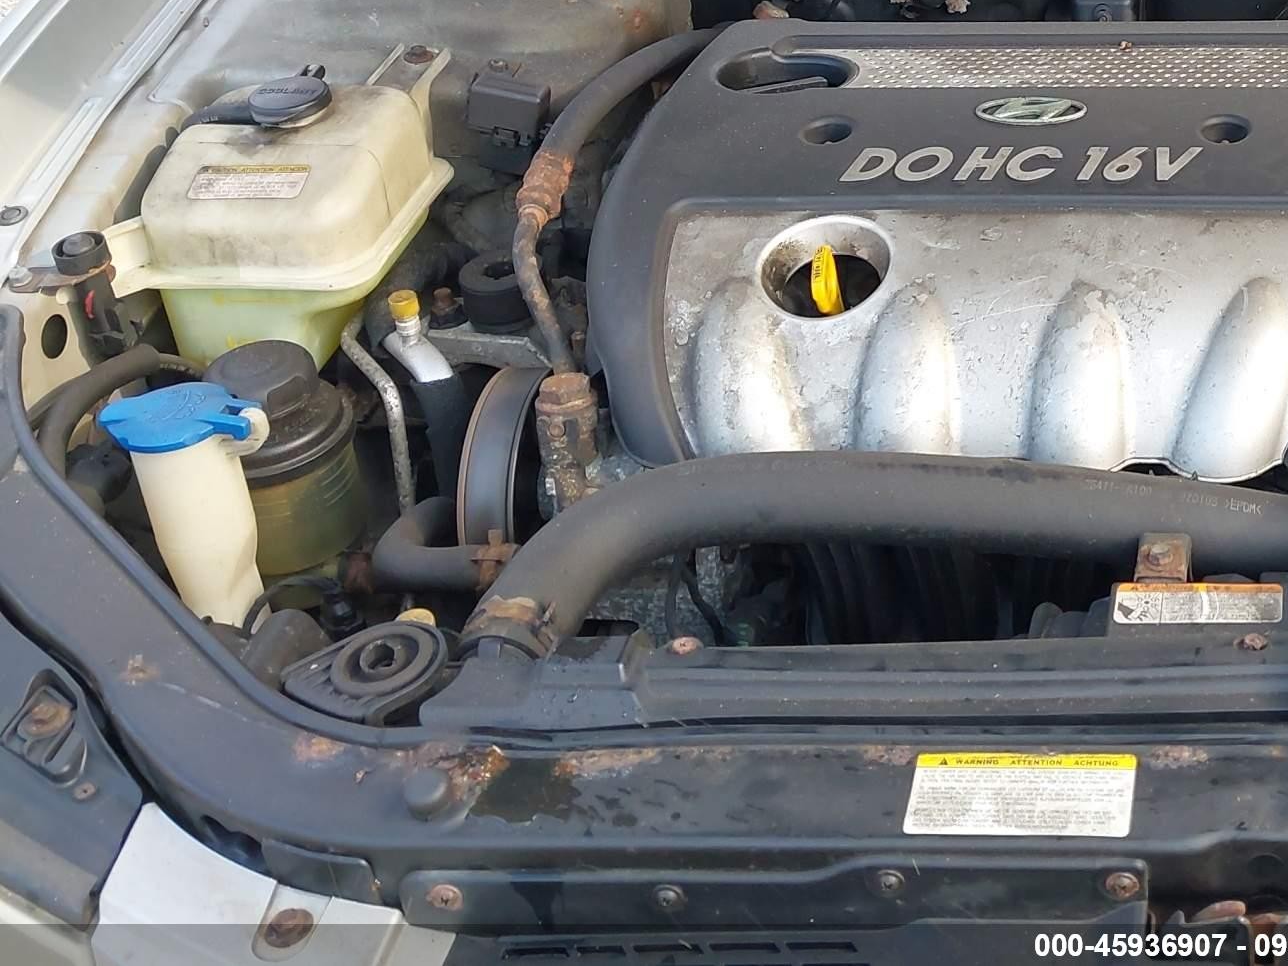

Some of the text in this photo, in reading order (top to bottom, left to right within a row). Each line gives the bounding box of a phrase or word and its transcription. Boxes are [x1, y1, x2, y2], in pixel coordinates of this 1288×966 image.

[255, 87, 318, 95] COOLANT
[1077, 146, 1203, 182] 16V
[1073, 759, 1119, 767] ACHTUNG
